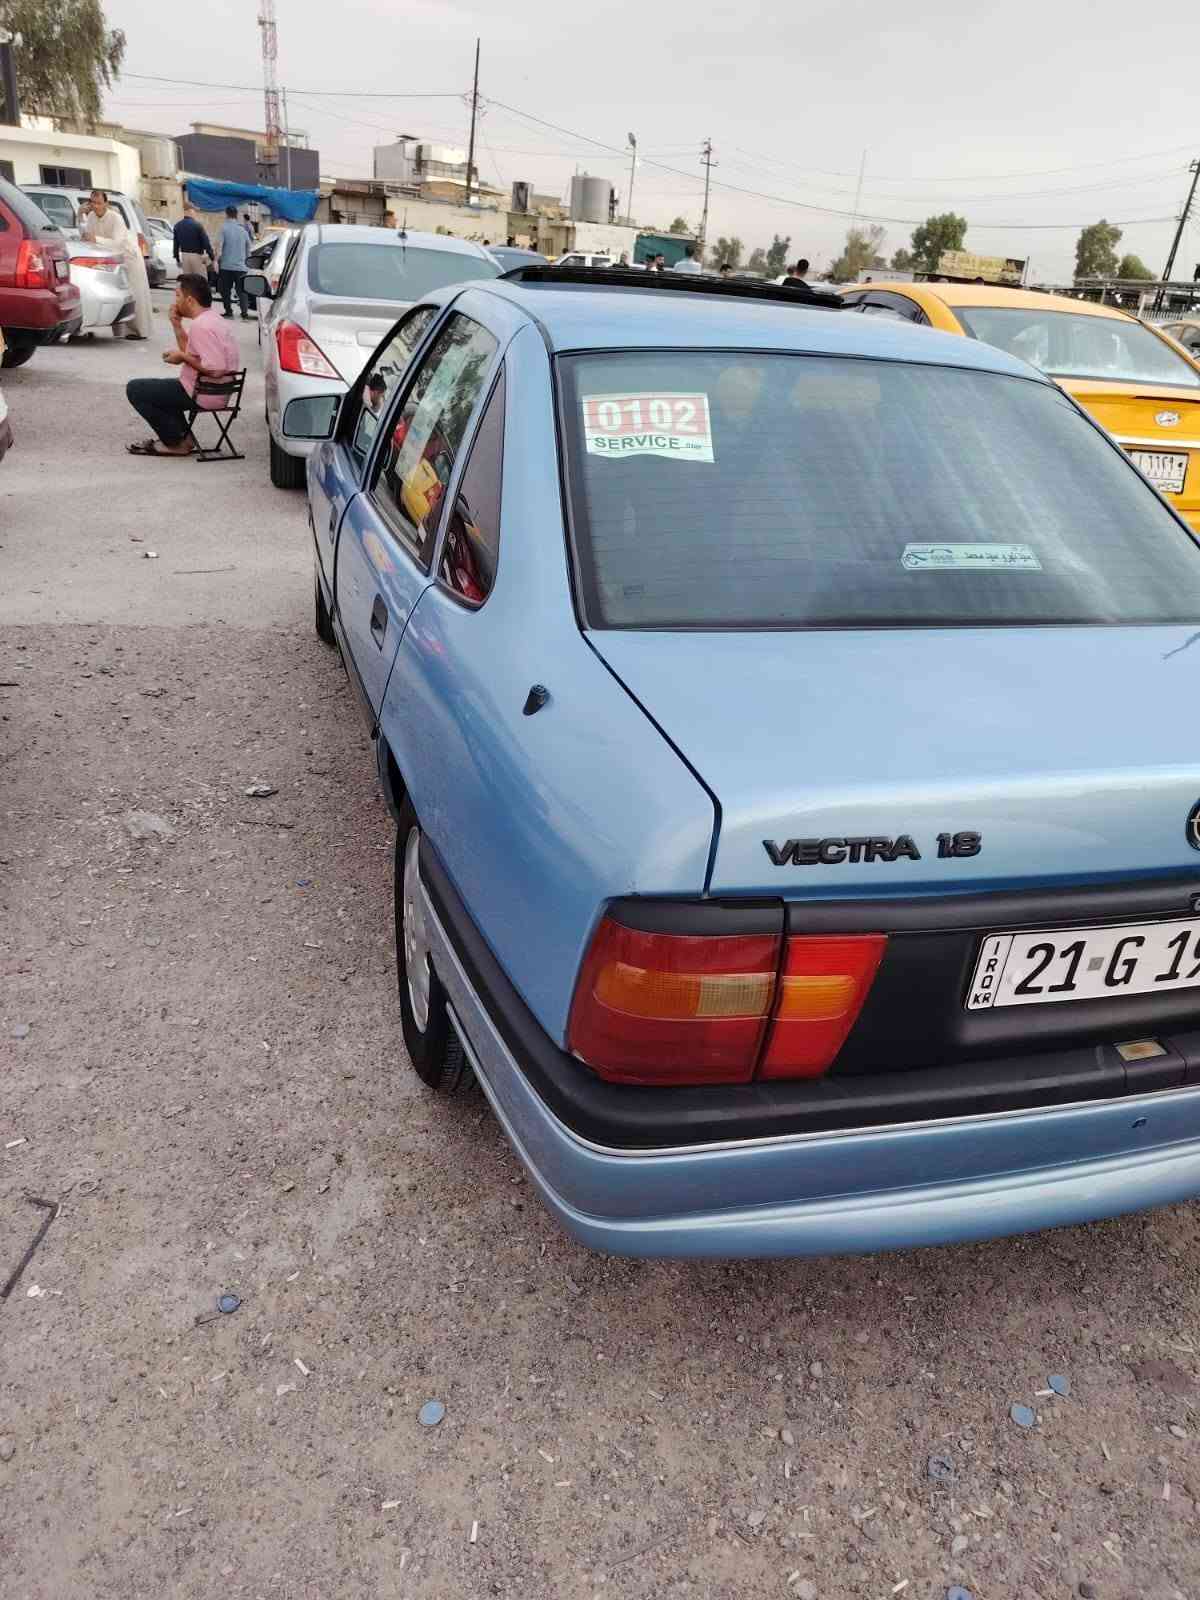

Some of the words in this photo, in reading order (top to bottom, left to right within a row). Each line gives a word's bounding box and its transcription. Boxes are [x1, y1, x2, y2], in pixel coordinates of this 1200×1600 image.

[598, 400, 699, 432] 0102
[594, 435, 681, 450] SERVICE
[762, 835, 922, 866] VECTRA
[1014, 940, 1088, 995] 21
[1104, 935, 1146, 987] G
[973, 992, 992, 1005] KR
